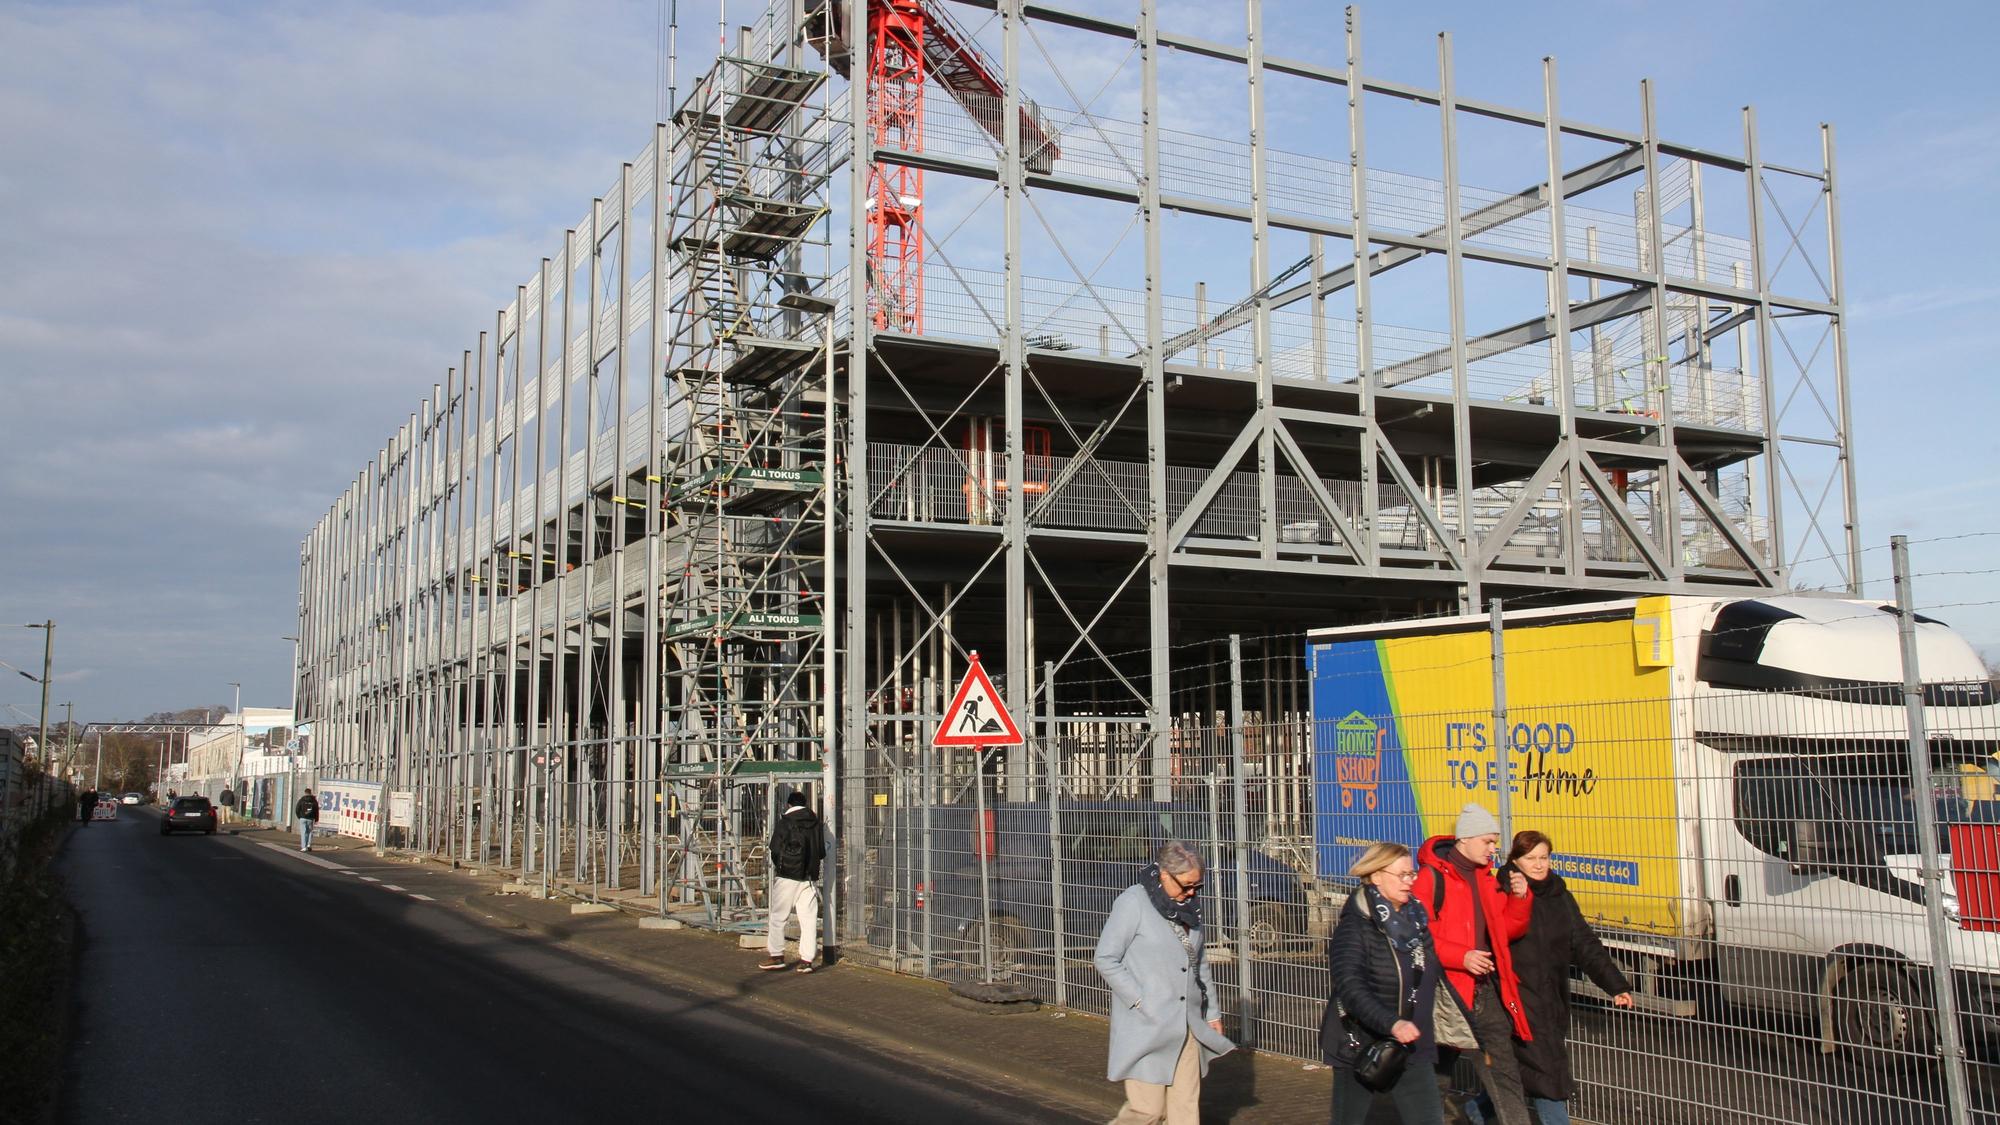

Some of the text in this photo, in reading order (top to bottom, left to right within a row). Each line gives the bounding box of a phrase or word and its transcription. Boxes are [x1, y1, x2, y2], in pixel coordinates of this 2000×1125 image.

[768, 471, 800, 480] TOKUS
[749, 615, 799, 624] ALI TOKUS
[1337, 731, 1376, 756] HOME
[1446, 722, 1487, 752] IT'S
[1342, 757, 1376, 782] SHOP
[1447, 760, 1478, 790] TO
[1523, 751, 1598, 802] Home
[1565, 860, 1577, 873] 65
[1579, 862, 1592, 875] 68
[1594, 863, 1607, 876] 62
[1609, 866, 1630, 879] 640
